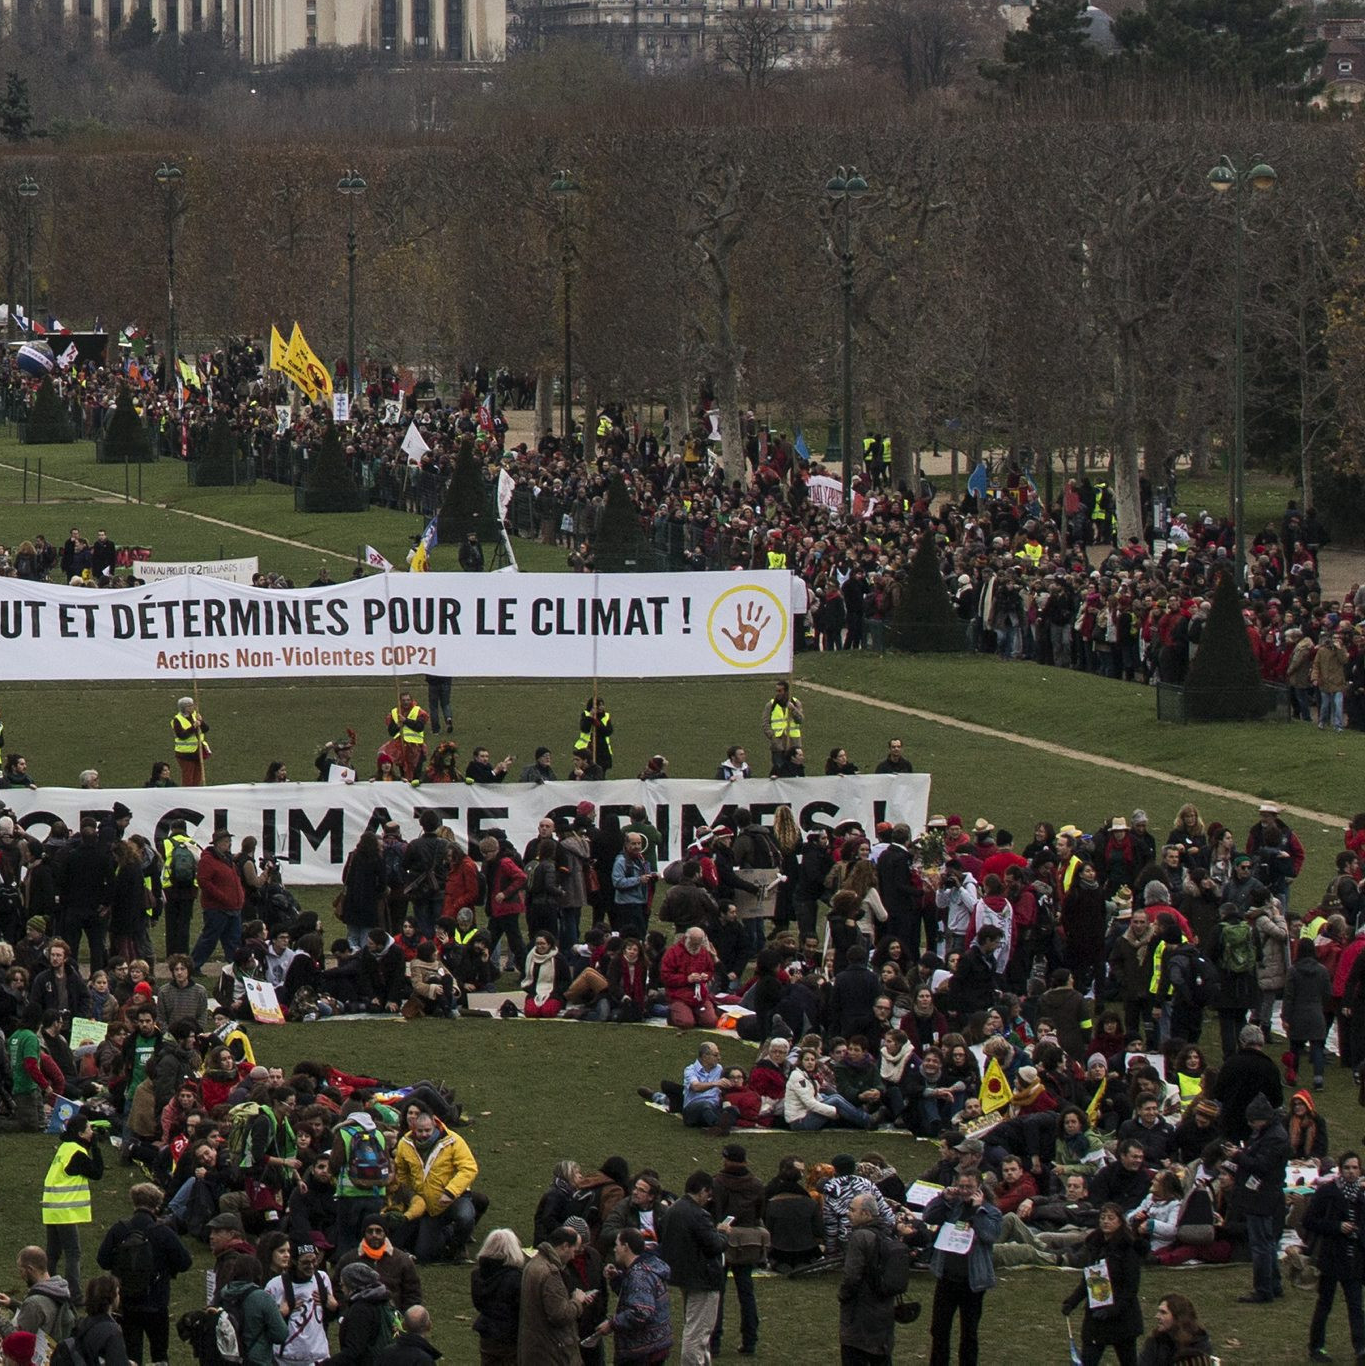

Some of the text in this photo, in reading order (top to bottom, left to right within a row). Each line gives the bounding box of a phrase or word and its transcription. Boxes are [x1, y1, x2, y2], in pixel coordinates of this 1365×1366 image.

[140, 565, 155, 575] NON
[156, 565, 166, 575] AU
[166, 565, 187, 575] PROJET
[188, 566, 196, 575] DE
[196, 564, 203, 575] 2
[58, 603, 100, 639] ET
[111, 594, 349, 640] DÉTERMINES
[363, 596, 463, 636] POUR
[476, 597, 518, 636] LE
[531, 596, 670, 636] CLIMAT
[156, 646, 437, 670] Actions Non-Violentes COP21
